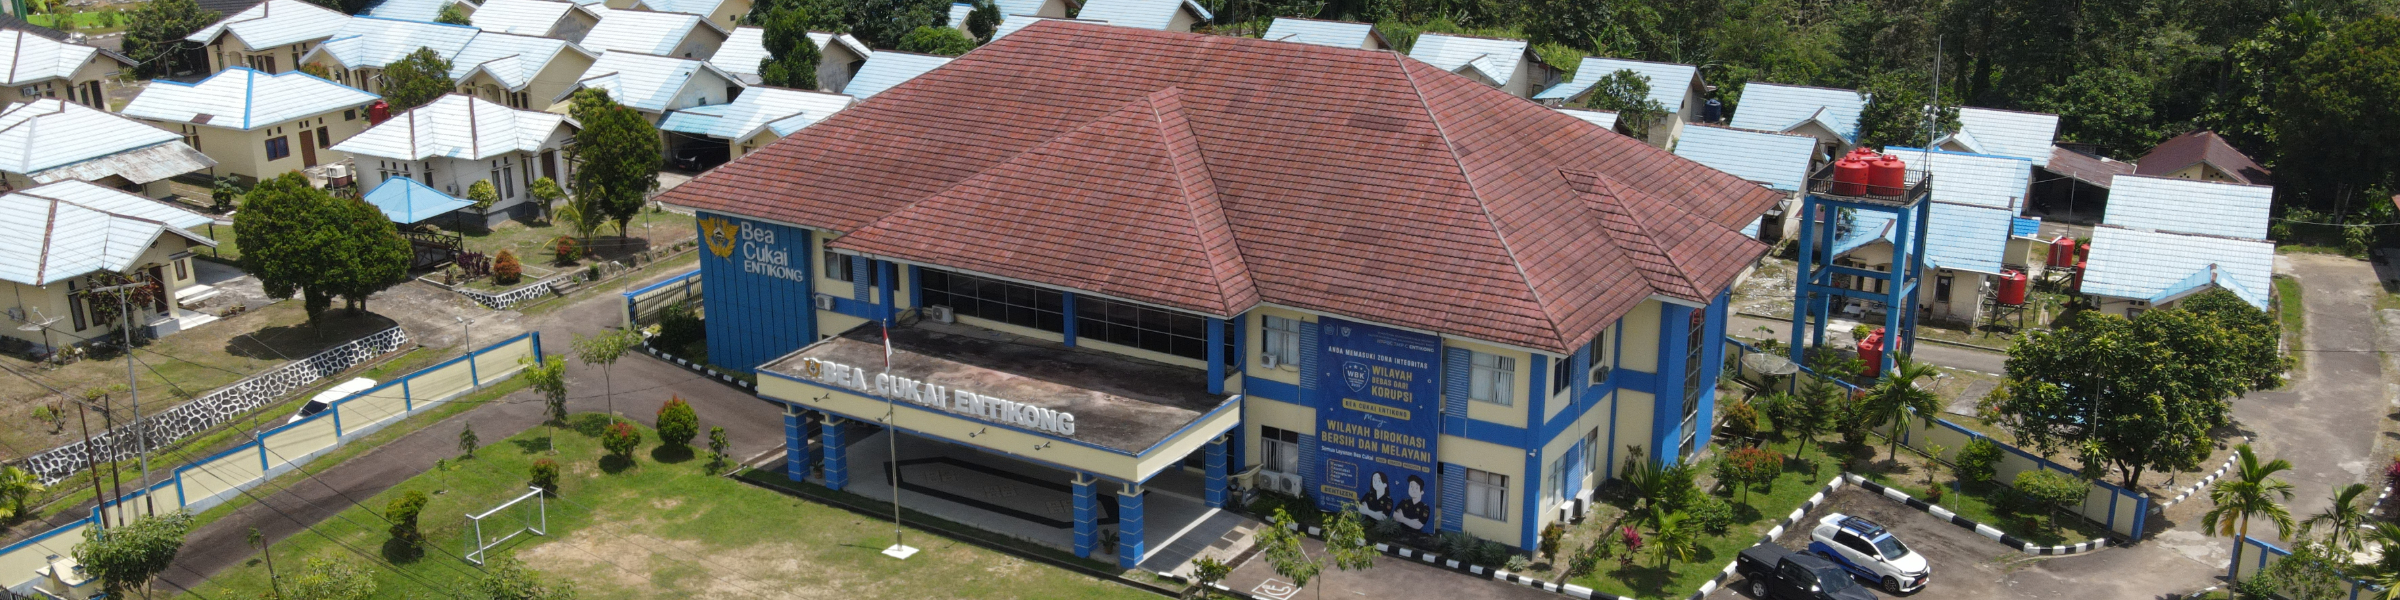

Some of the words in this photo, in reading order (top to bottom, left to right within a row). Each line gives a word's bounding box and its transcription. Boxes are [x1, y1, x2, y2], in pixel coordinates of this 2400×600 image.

[740, 221, 775, 245] Bea
[743, 241, 788, 266] Cukai
[744, 260, 803, 283] ENTIKONG
[1328, 345, 1343, 355] ANDA
[1345, 349, 1376, 360] MEMASUKI
[1377, 354, 1392, 363] ZONA
[1394, 358, 1428, 370] INTEGRITAS
[1408, 344, 1435, 353] ENTIKONG
[1347, 370, 1365, 379] WBK
[1371, 365, 1413, 381] WILAYAH
[1371, 376, 1392, 387] BEBAS
[1393, 380, 1409, 390] DARI
[823, 360, 867, 391] BEA
[874, 373, 946, 409] CUKAI
[954, 389, 1075, 436] ENTIKONG
[1371, 385, 1413, 403] KORUPSI
[1345, 400, 1357, 409] BEA
[1358, 402, 1377, 412] CUKAI
[1378, 406, 1407, 418] ENTIKONG
[1326, 419, 1371, 438] WILAYAH
[1374, 428, 1426, 449] BIROKRASI
[1321, 430, 1355, 447] BERSIH
[1358, 438, 1378, 452] DAN
[1381, 443, 1431, 463] MELAYANI
[1321, 445, 1336, 453] Semua
[1335, 448, 1353, 457] Layanan
[1353, 451, 1362, 459] Bea
[1361, 453, 1374, 461] Cukai
